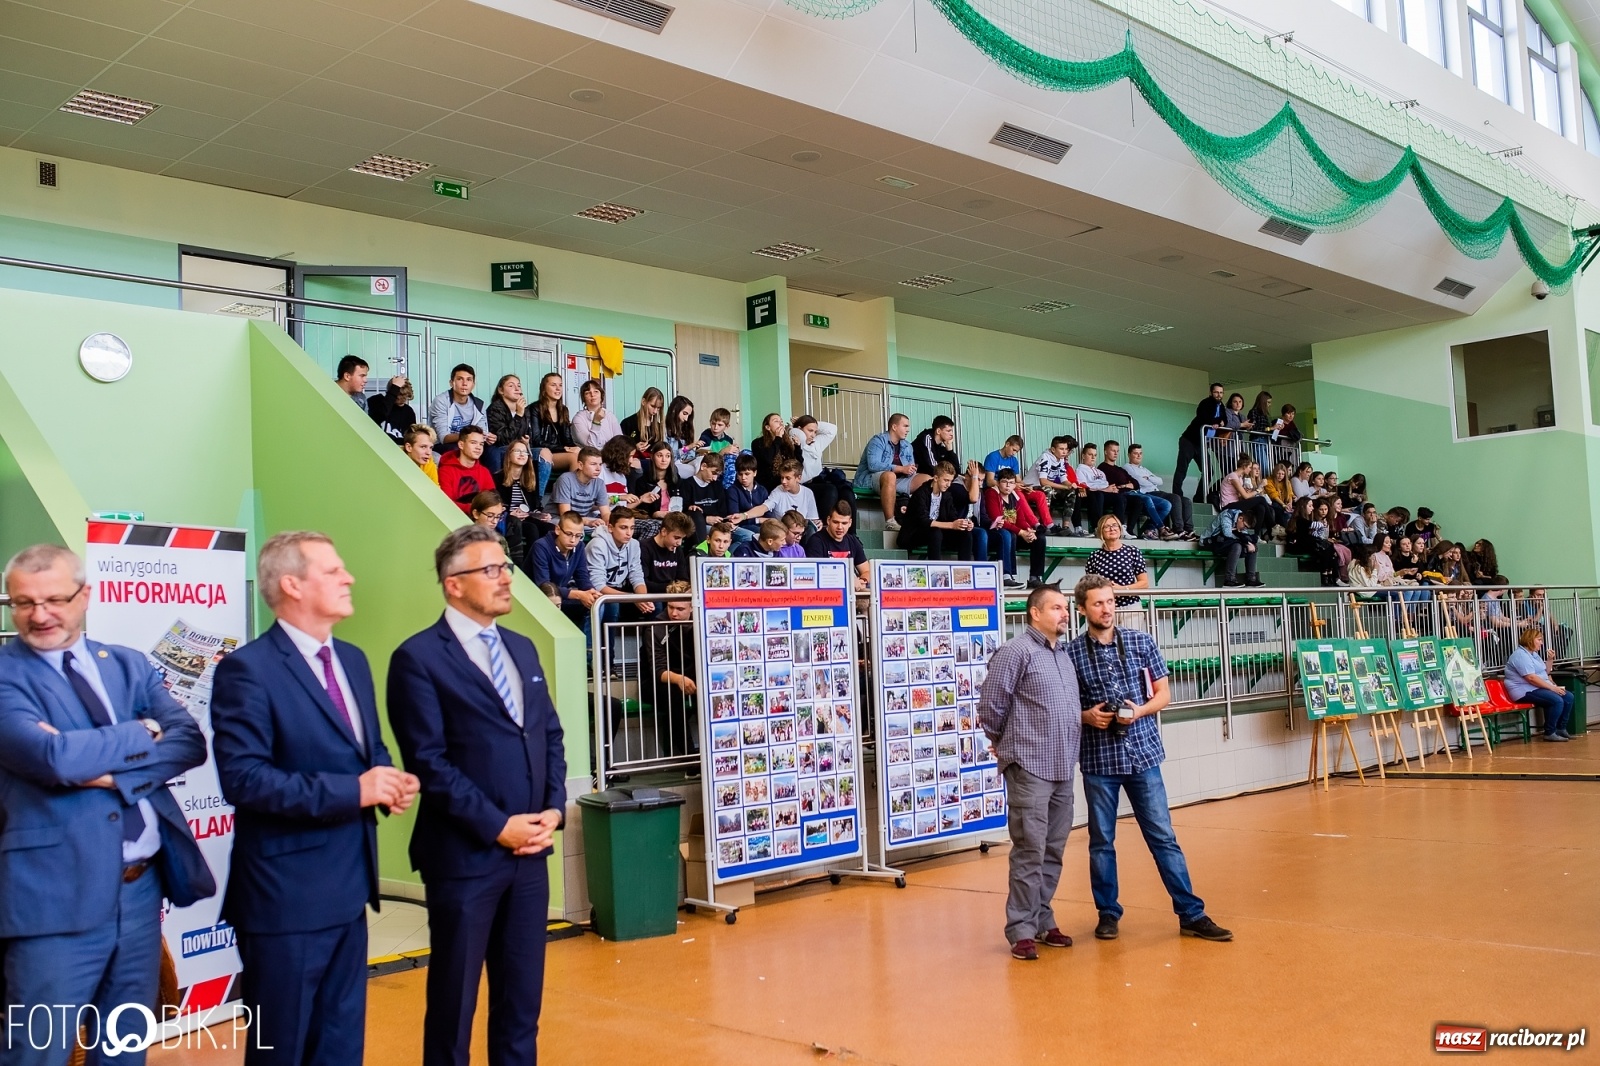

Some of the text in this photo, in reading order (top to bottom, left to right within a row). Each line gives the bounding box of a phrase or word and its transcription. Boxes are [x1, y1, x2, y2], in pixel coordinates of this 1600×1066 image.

[503, 271, 521, 288] F
[753, 296, 771, 305] SEKTOR
[755, 304, 768, 324] F
[98, 556, 178, 577] wiarygodna
[100, 581, 227, 608] INFORMACJA
[803, 614, 832, 622] TENERYFA
[189, 631, 221, 645] nowiny
